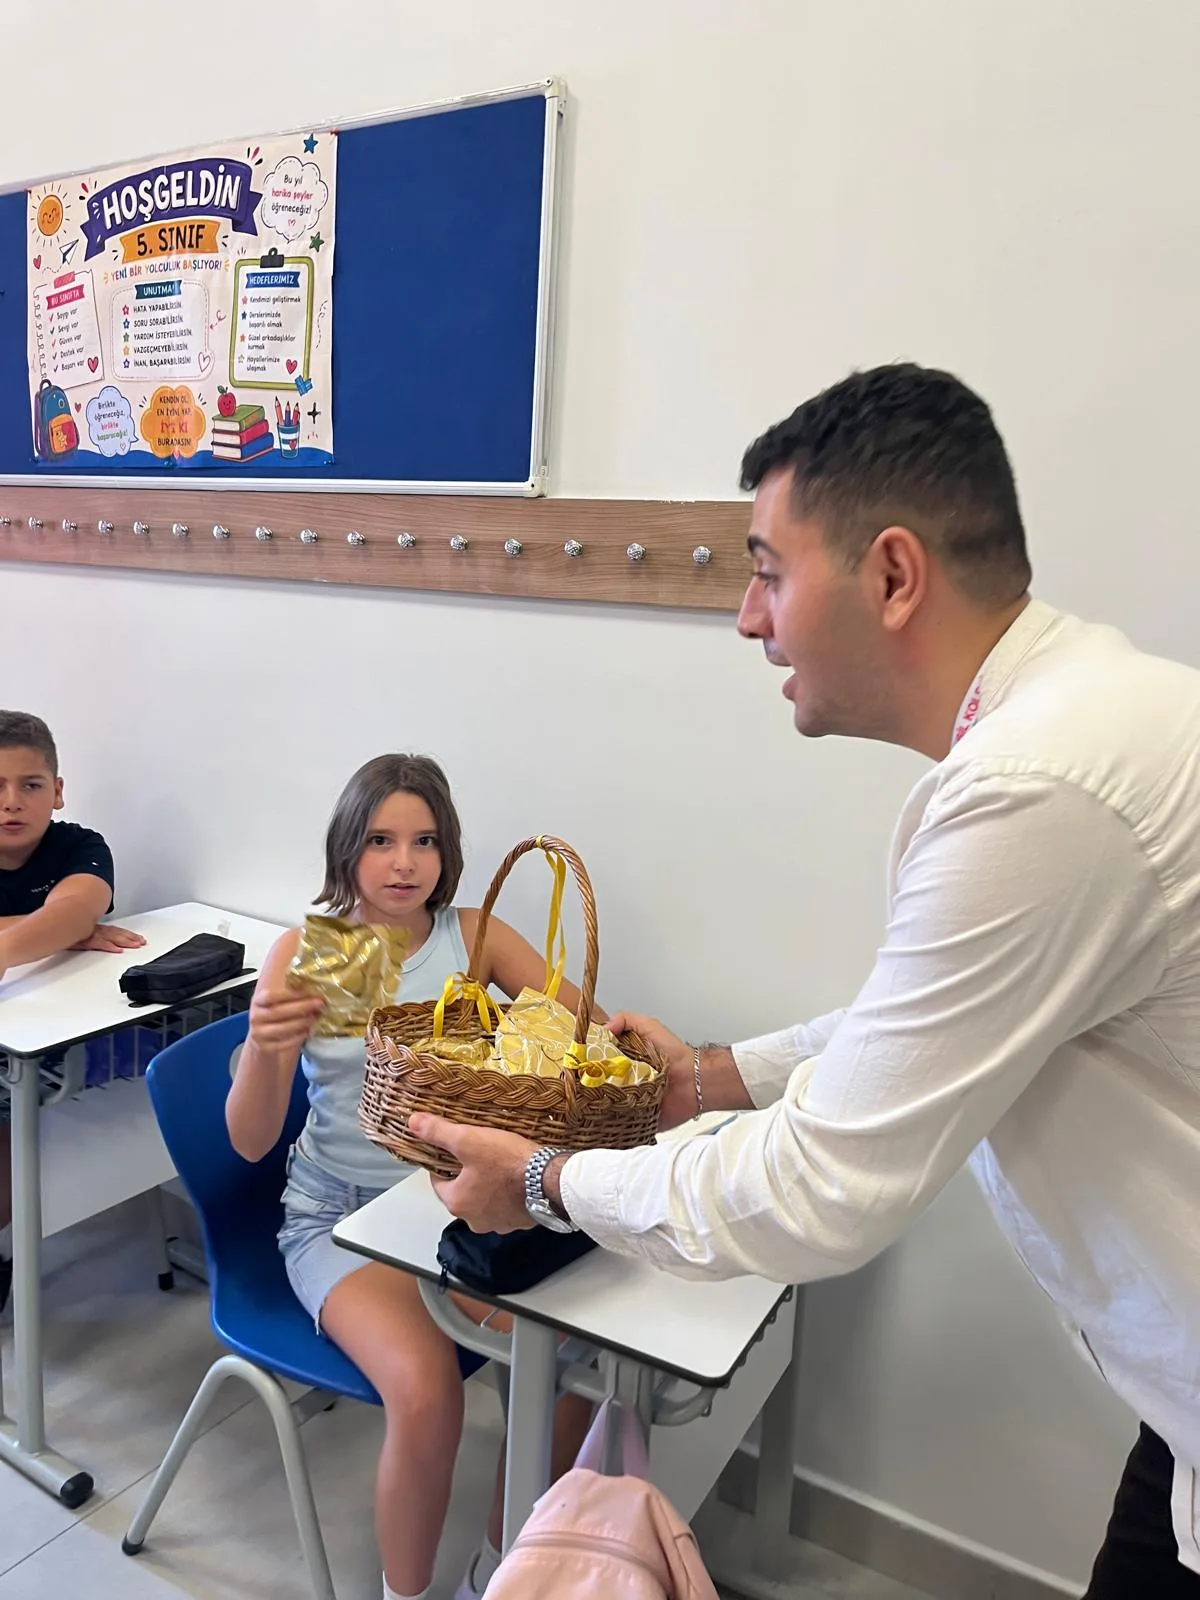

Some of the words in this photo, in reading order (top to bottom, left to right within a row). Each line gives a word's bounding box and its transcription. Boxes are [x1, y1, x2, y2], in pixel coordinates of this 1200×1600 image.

[284, 174, 292, 184] Bu
[294, 175, 303, 187] yıl
[102, 164, 241, 230] HOŞGELDİN
[272, 188, 292, 198] harika
[292, 190, 314, 204] şeyler
[271, 203, 312, 216] öğreneceğiz!
[137, 232, 153, 256] 5.
[158, 223, 206, 252] SINIF
[110, 268, 128, 282] YENİ
[130, 265, 142, 276] BİR
[146, 261, 180, 274] YOLCULUK
[182, 260, 222, 272] BAŞLIYOR!
[250, 274, 294, 284] HEDEFLERİMİZ
[143, 285, 176, 296] UNUTMA!
[272, 296, 301, 304] geliştirmek
[134, 305, 146, 313] HATA
[58, 324, 70, 334] Sevgi
[71, 321, 79, 329] var
[134, 320, 148, 328] SORU
[58, 336, 73, 346] Güven
[134, 332, 154, 340] YARDIM
[262, 334, 296, 342] arkadaşlıklar
[60, 348, 75, 358] Destek
[246, 356, 280, 364] Hayallerimize
[160, 396, 178, 404] KENDİN
[98, 401, 116, 410] Birlikte
[101, 422, 118, 430] birlikte
[97, 430, 128, 441] başaracağız!
[158, 438, 192, 447] BURADASIN!
